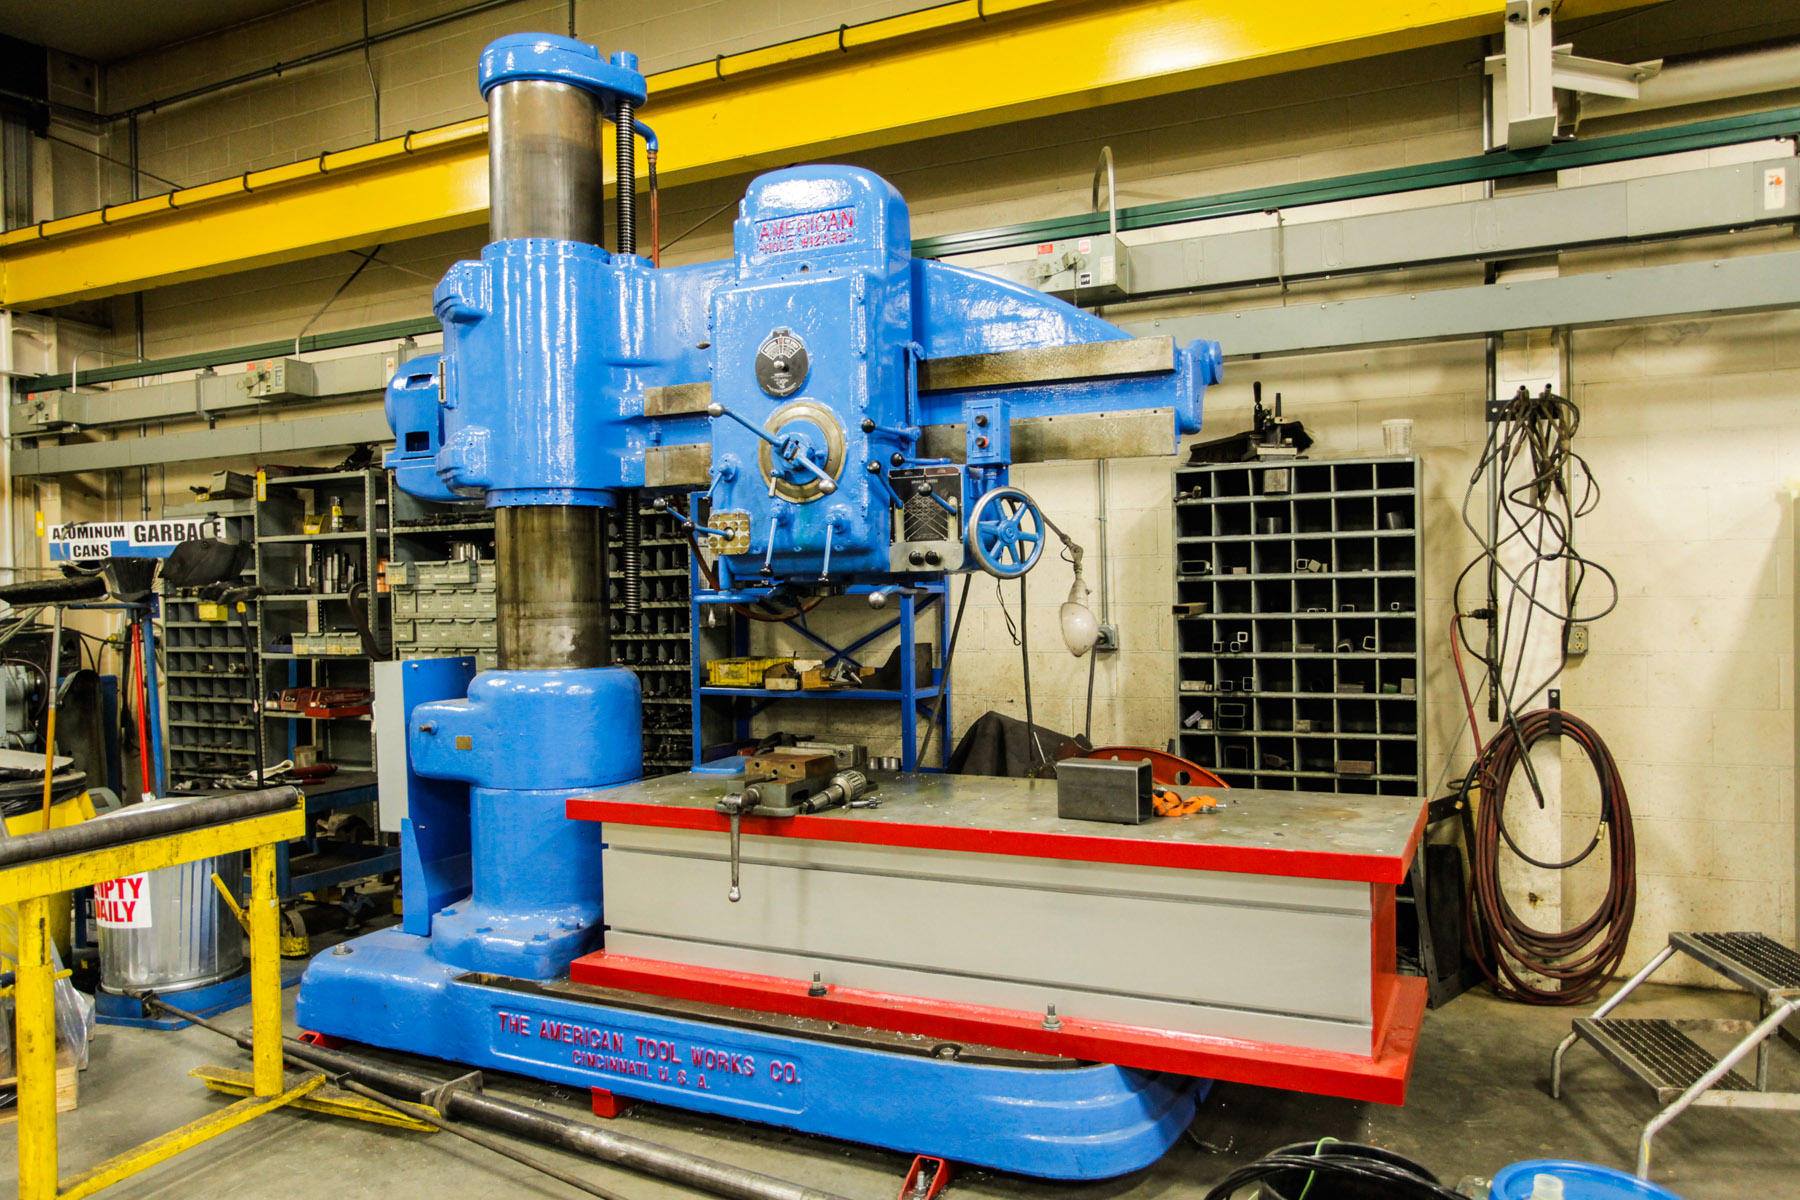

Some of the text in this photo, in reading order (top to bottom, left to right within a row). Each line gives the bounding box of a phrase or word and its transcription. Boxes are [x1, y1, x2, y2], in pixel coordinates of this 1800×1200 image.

[759, 208, 854, 242] AMERICAN
[73, 544, 109, 558] CANS
[498, 1011, 802, 1084] THE AMERICAN TOOL WORKS CO.
[697, 1073, 711, 1090] A.
